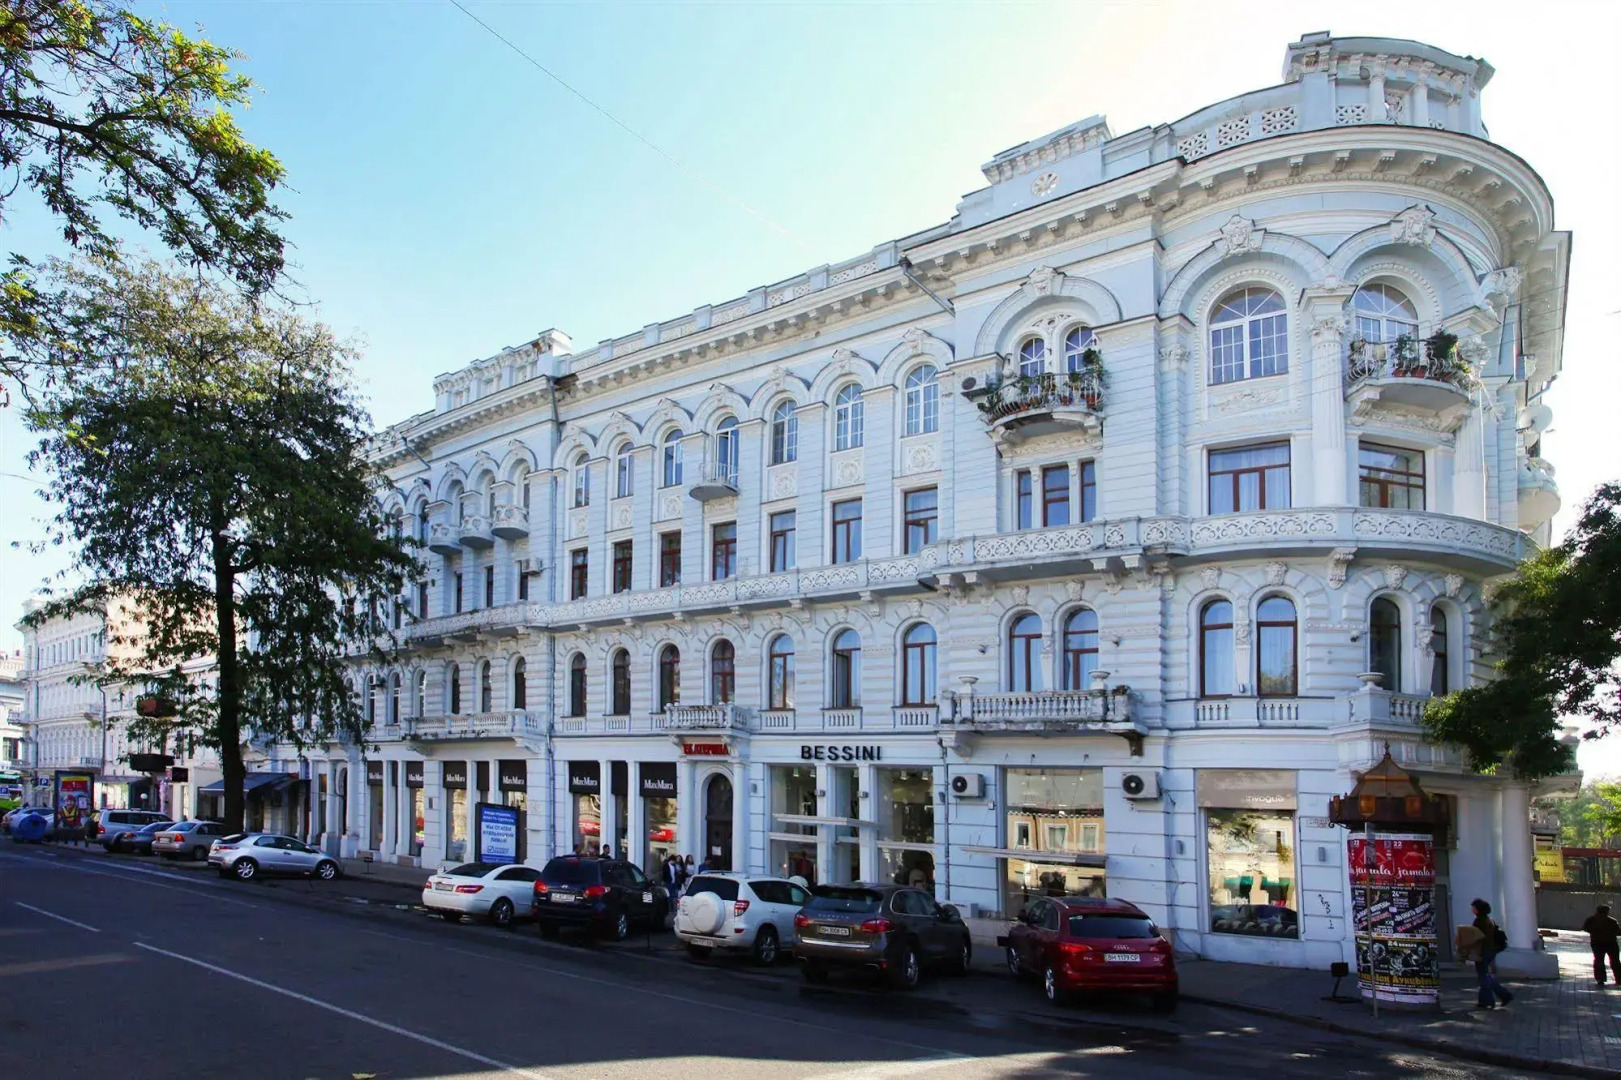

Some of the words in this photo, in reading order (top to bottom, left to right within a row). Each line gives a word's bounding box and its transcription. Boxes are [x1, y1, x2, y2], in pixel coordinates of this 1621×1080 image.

[801, 745, 881, 761] BESSINI
[572, 776, 598, 786] MaxMara
[644, 779, 674, 790] MaxMara
[1396, 865, 1431, 879] jamala
